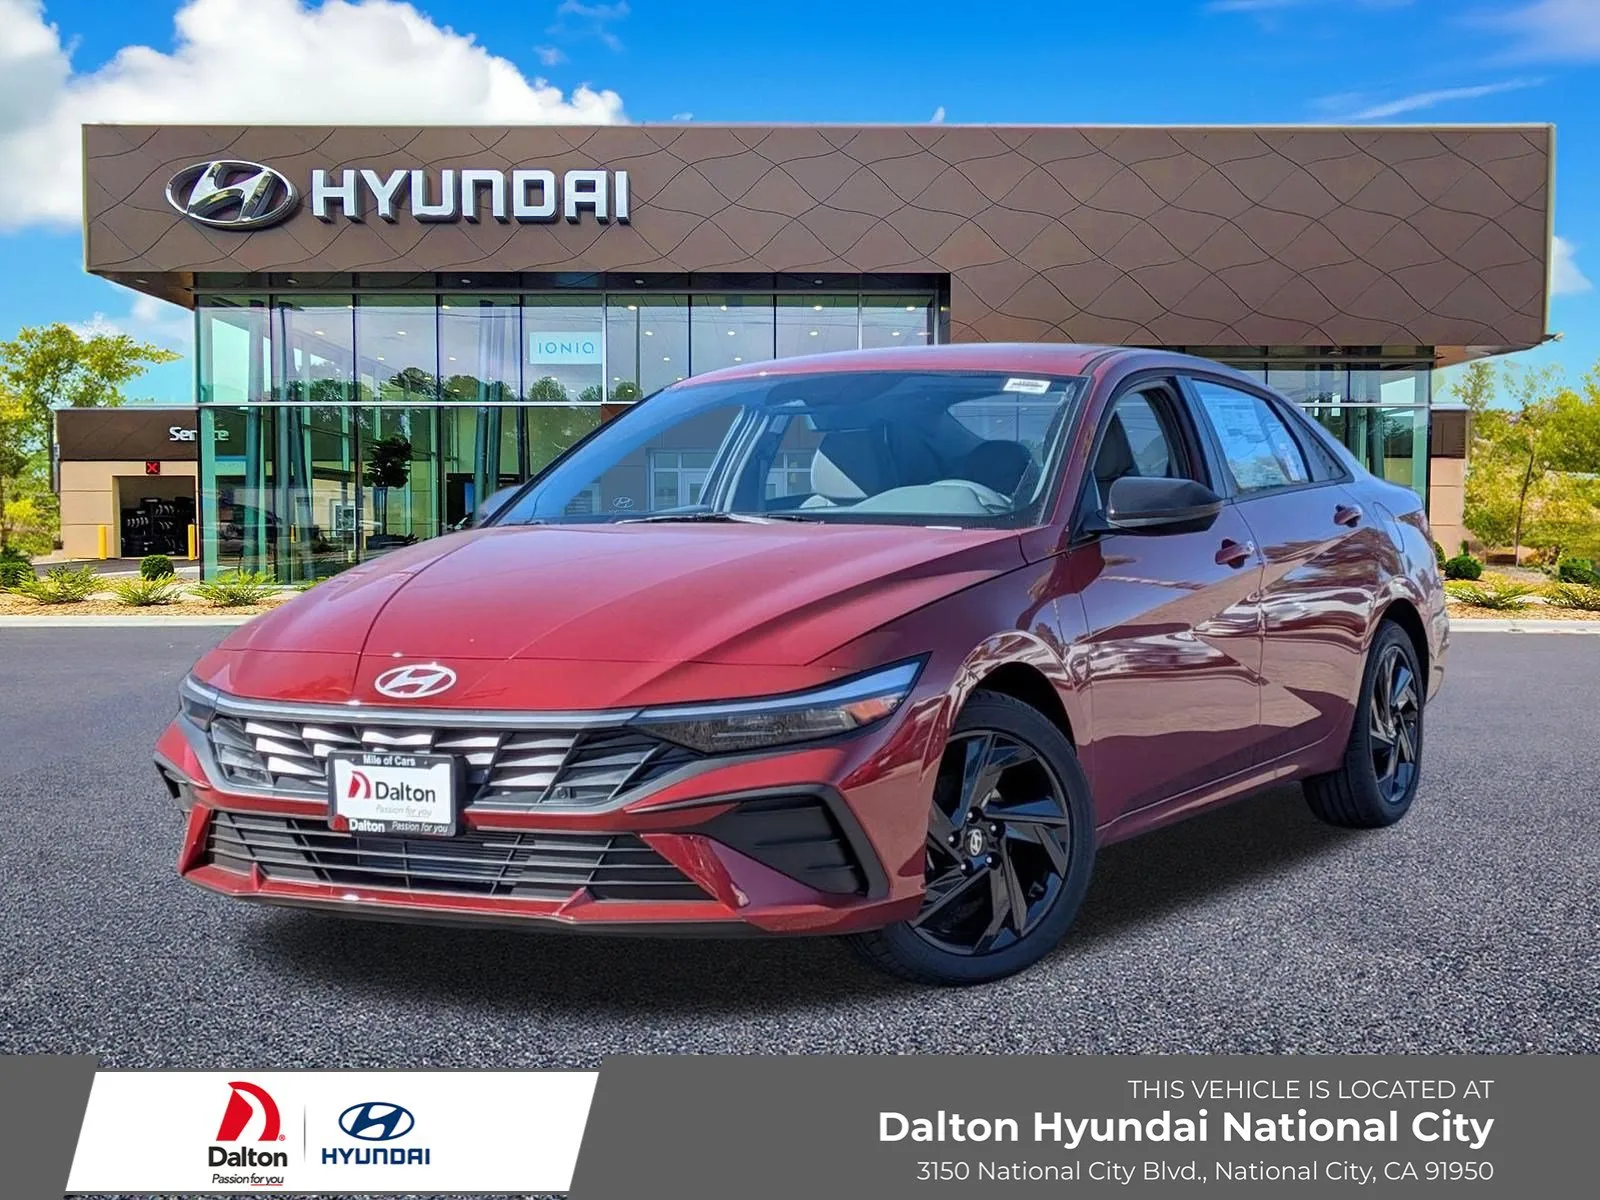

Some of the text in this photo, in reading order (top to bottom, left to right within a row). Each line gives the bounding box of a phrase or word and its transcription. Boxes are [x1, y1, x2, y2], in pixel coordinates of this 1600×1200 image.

[312, 169, 630, 222] HYUNDAI
[538, 341, 595, 354] IONIQ
[169, 426, 229, 441] Serce
[363, 755, 416, 766] Mile of Cars
[375, 781, 436, 802] Dalton
[349, 820, 448, 833] Dalton Passion for you
